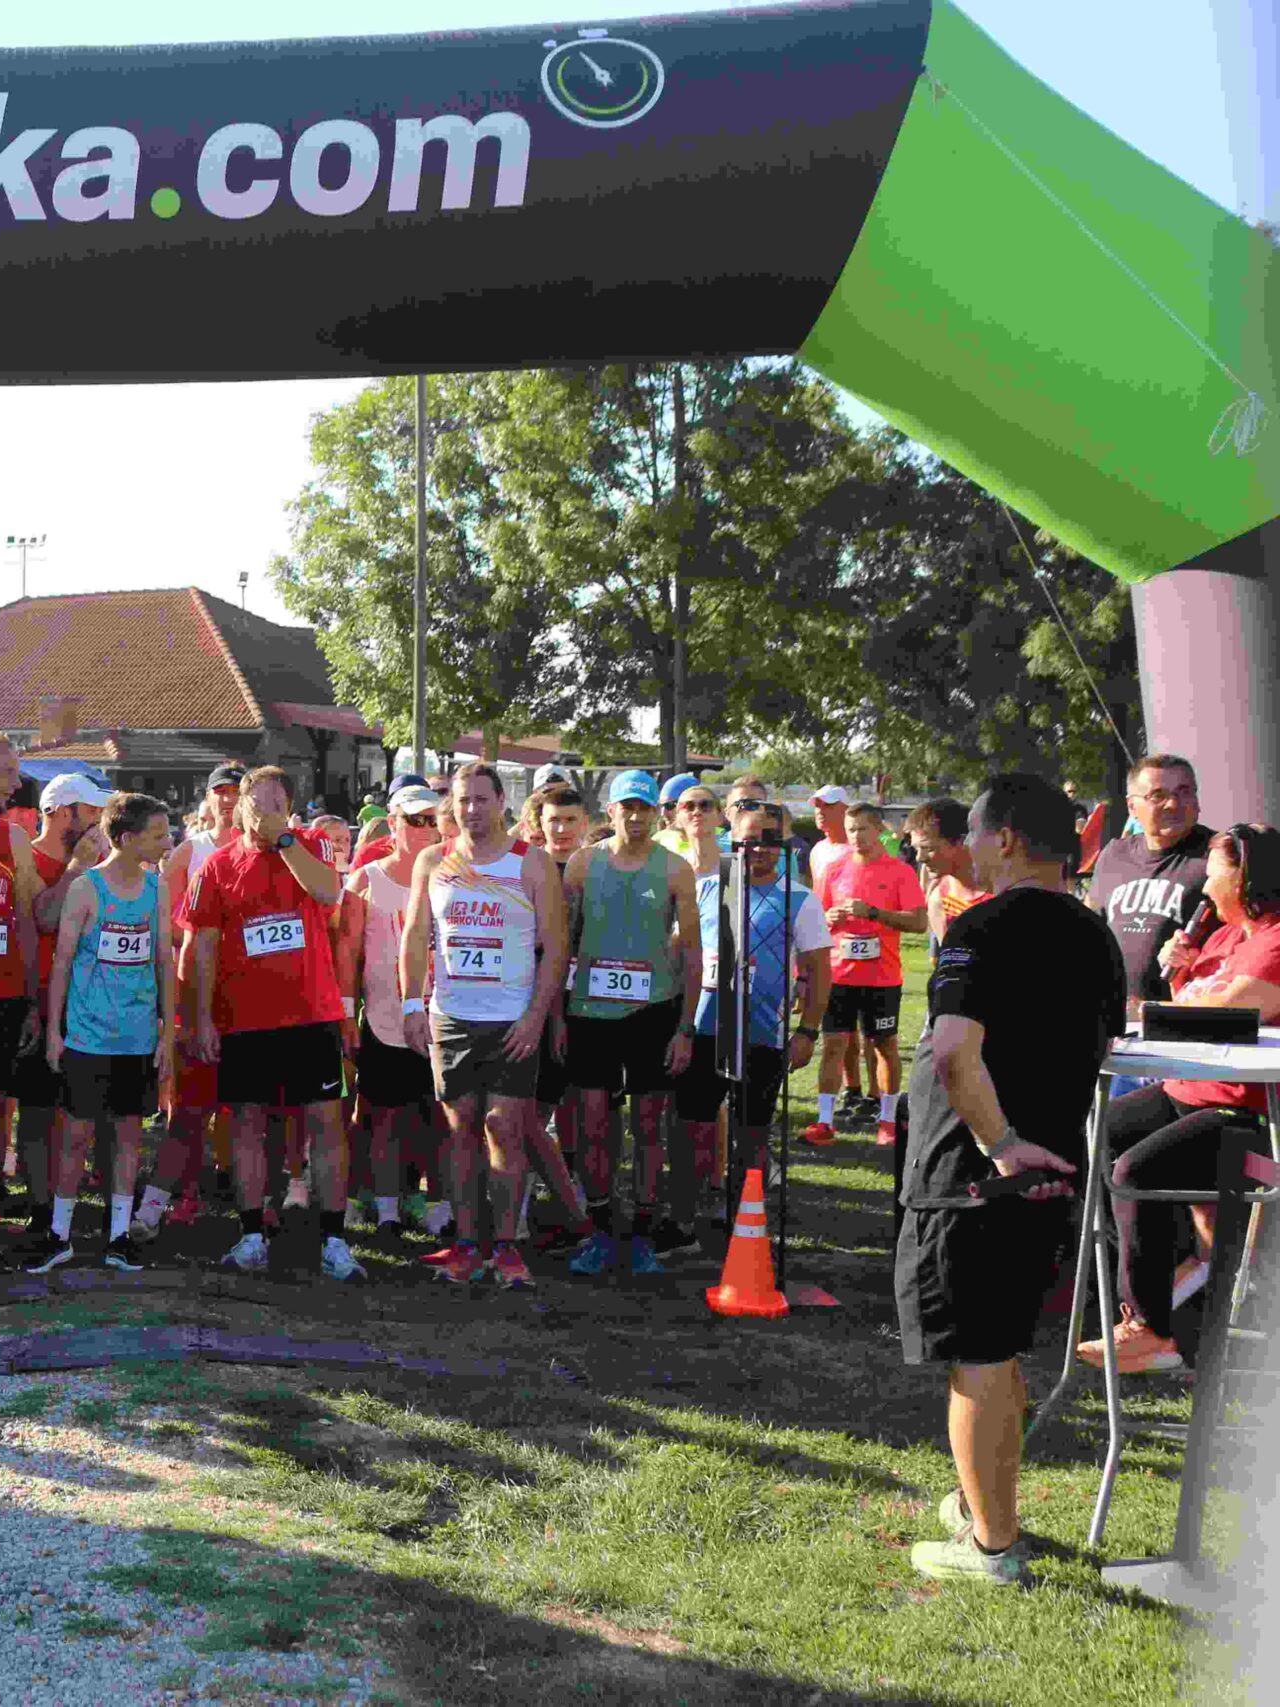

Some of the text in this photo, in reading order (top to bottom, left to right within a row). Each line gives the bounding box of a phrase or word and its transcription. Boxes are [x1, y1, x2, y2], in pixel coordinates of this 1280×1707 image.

[1108, 878, 1185, 925] PUMA
[255, 924, 293, 945] 128
[117, 936, 141, 954] 94
[850, 941, 869, 954] 82
[460, 950, 485, 968] 74
[607, 972, 632, 991] 30
